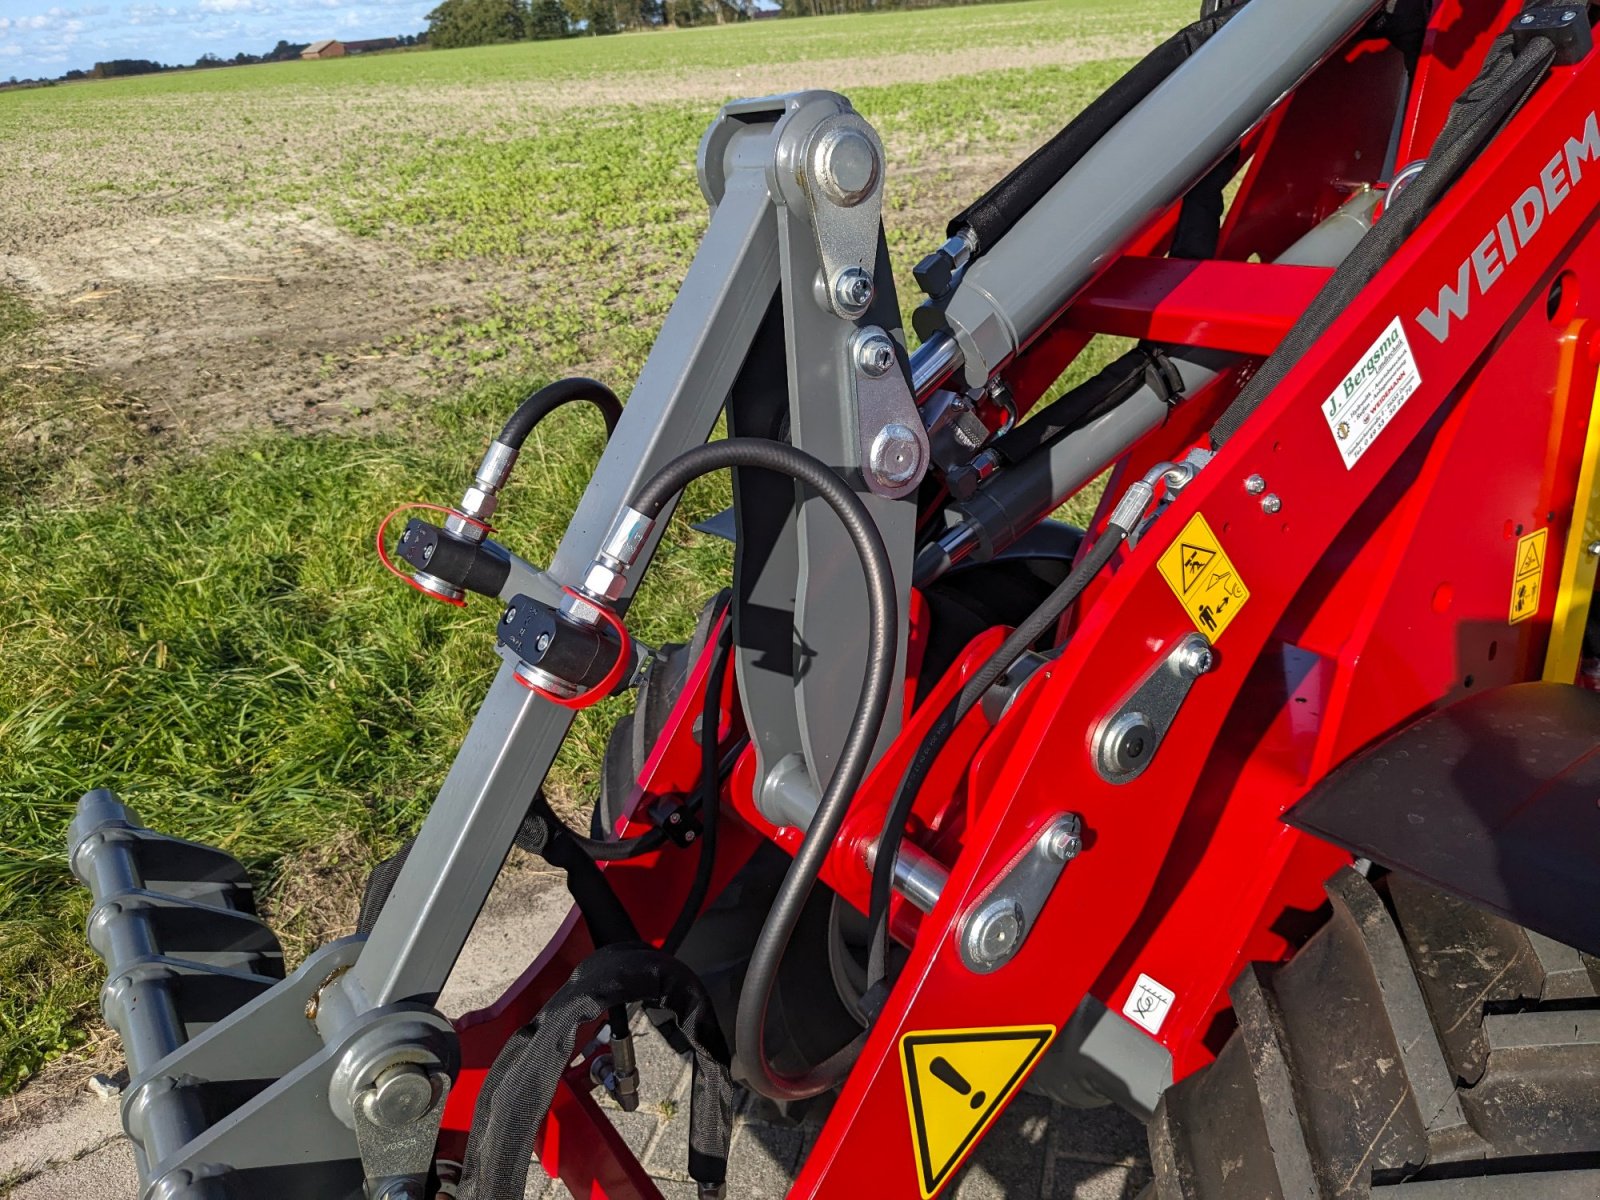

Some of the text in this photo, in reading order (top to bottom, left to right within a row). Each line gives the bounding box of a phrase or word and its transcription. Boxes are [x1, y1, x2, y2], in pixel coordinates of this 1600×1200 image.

[1329, 327, 1399, 417] J. Bergsma
[1374, 338, 1404, 375] Landtechnik
[1369, 370, 1406, 414] WEIDEMANN
